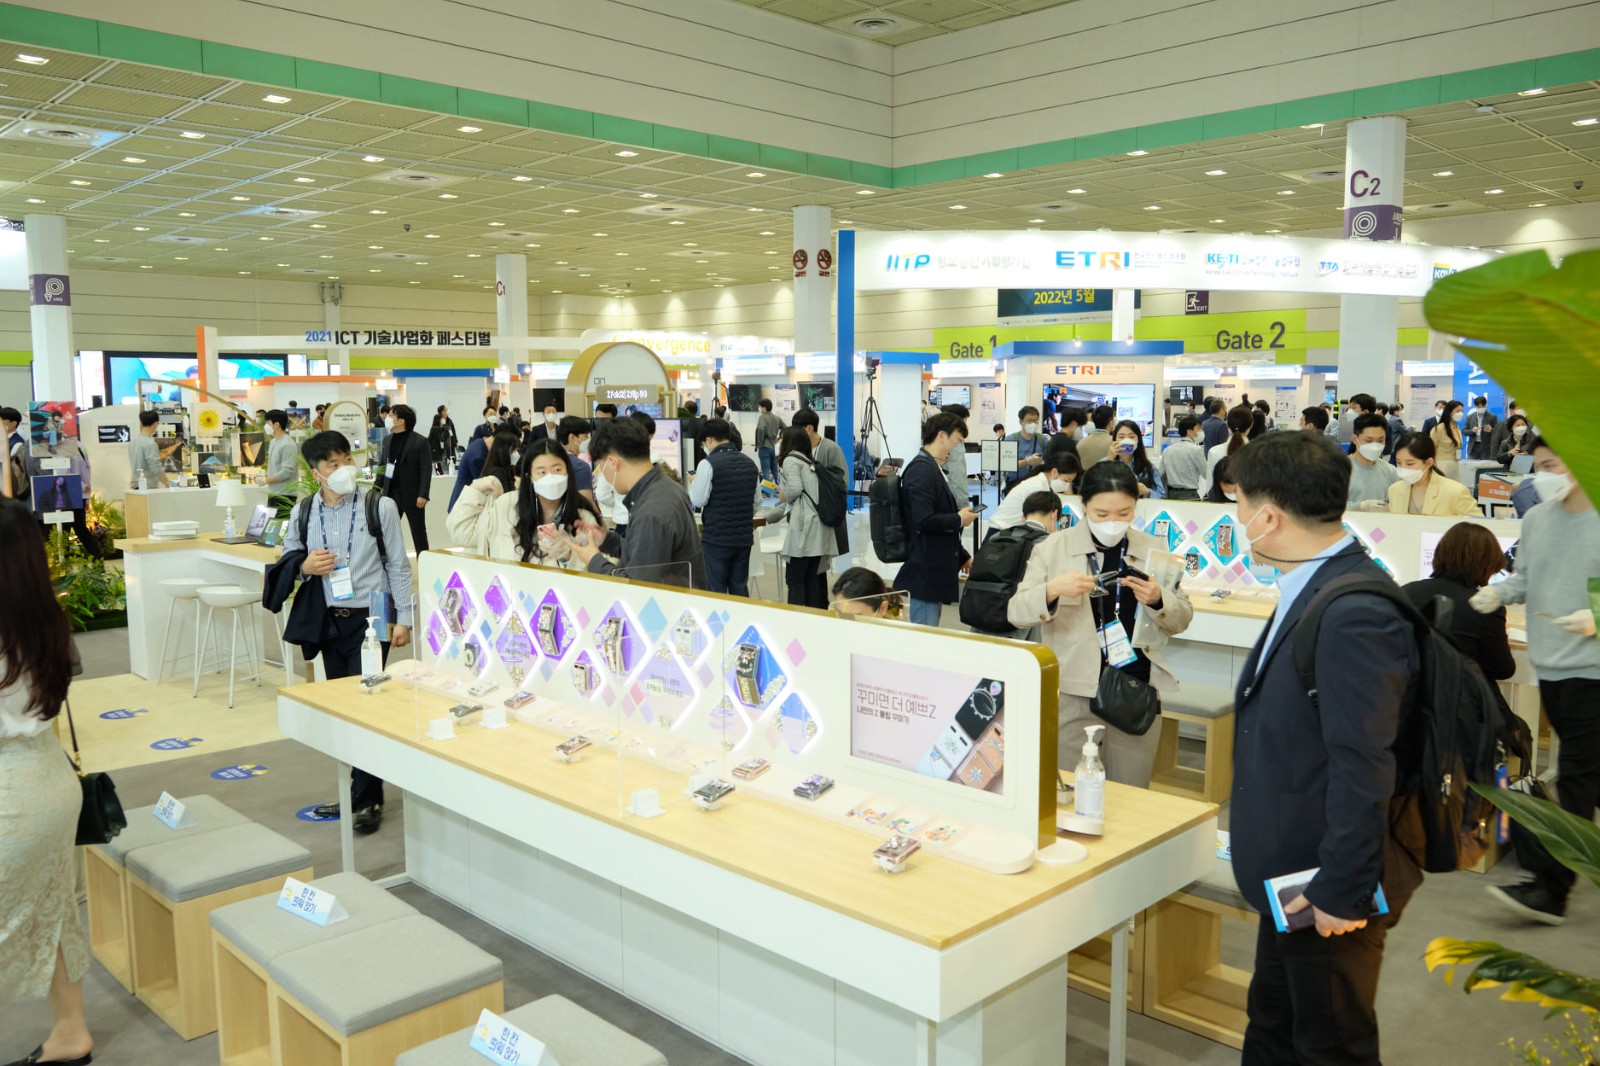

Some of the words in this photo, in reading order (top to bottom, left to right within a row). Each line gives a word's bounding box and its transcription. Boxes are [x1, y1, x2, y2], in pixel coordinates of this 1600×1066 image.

[1350, 170, 1381, 198] C2
[1055, 251, 1130, 270] ETRI
[1206, 253, 1239, 264] KETI
[1319, 261, 1339, 271] TTA
[496, 280, 506, 296] C1
[1033, 289, 1073, 305] 2022년
[1075, 287, 1095, 304] 5월
[305, 331, 333, 342] 2021
[335, 331, 360, 345] ICT
[364, 330, 434, 346] 기술사업화
[436, 331, 491, 346] 페스티벌
[1216, 330, 1263, 350] Gate
[1269, 321, 1286, 349] 2
[950, 341, 984, 359] Gate
[989, 334, 998, 348] 1
[1055, 365, 1100, 375] ETRI
[857, 688, 890, 710] 꾸미면
[892, 696, 903, 713] 더
[856, 704, 874, 717] 나만의
[874, 709, 879, 717] Z
[892, 712, 910, 724] 꾸미기
